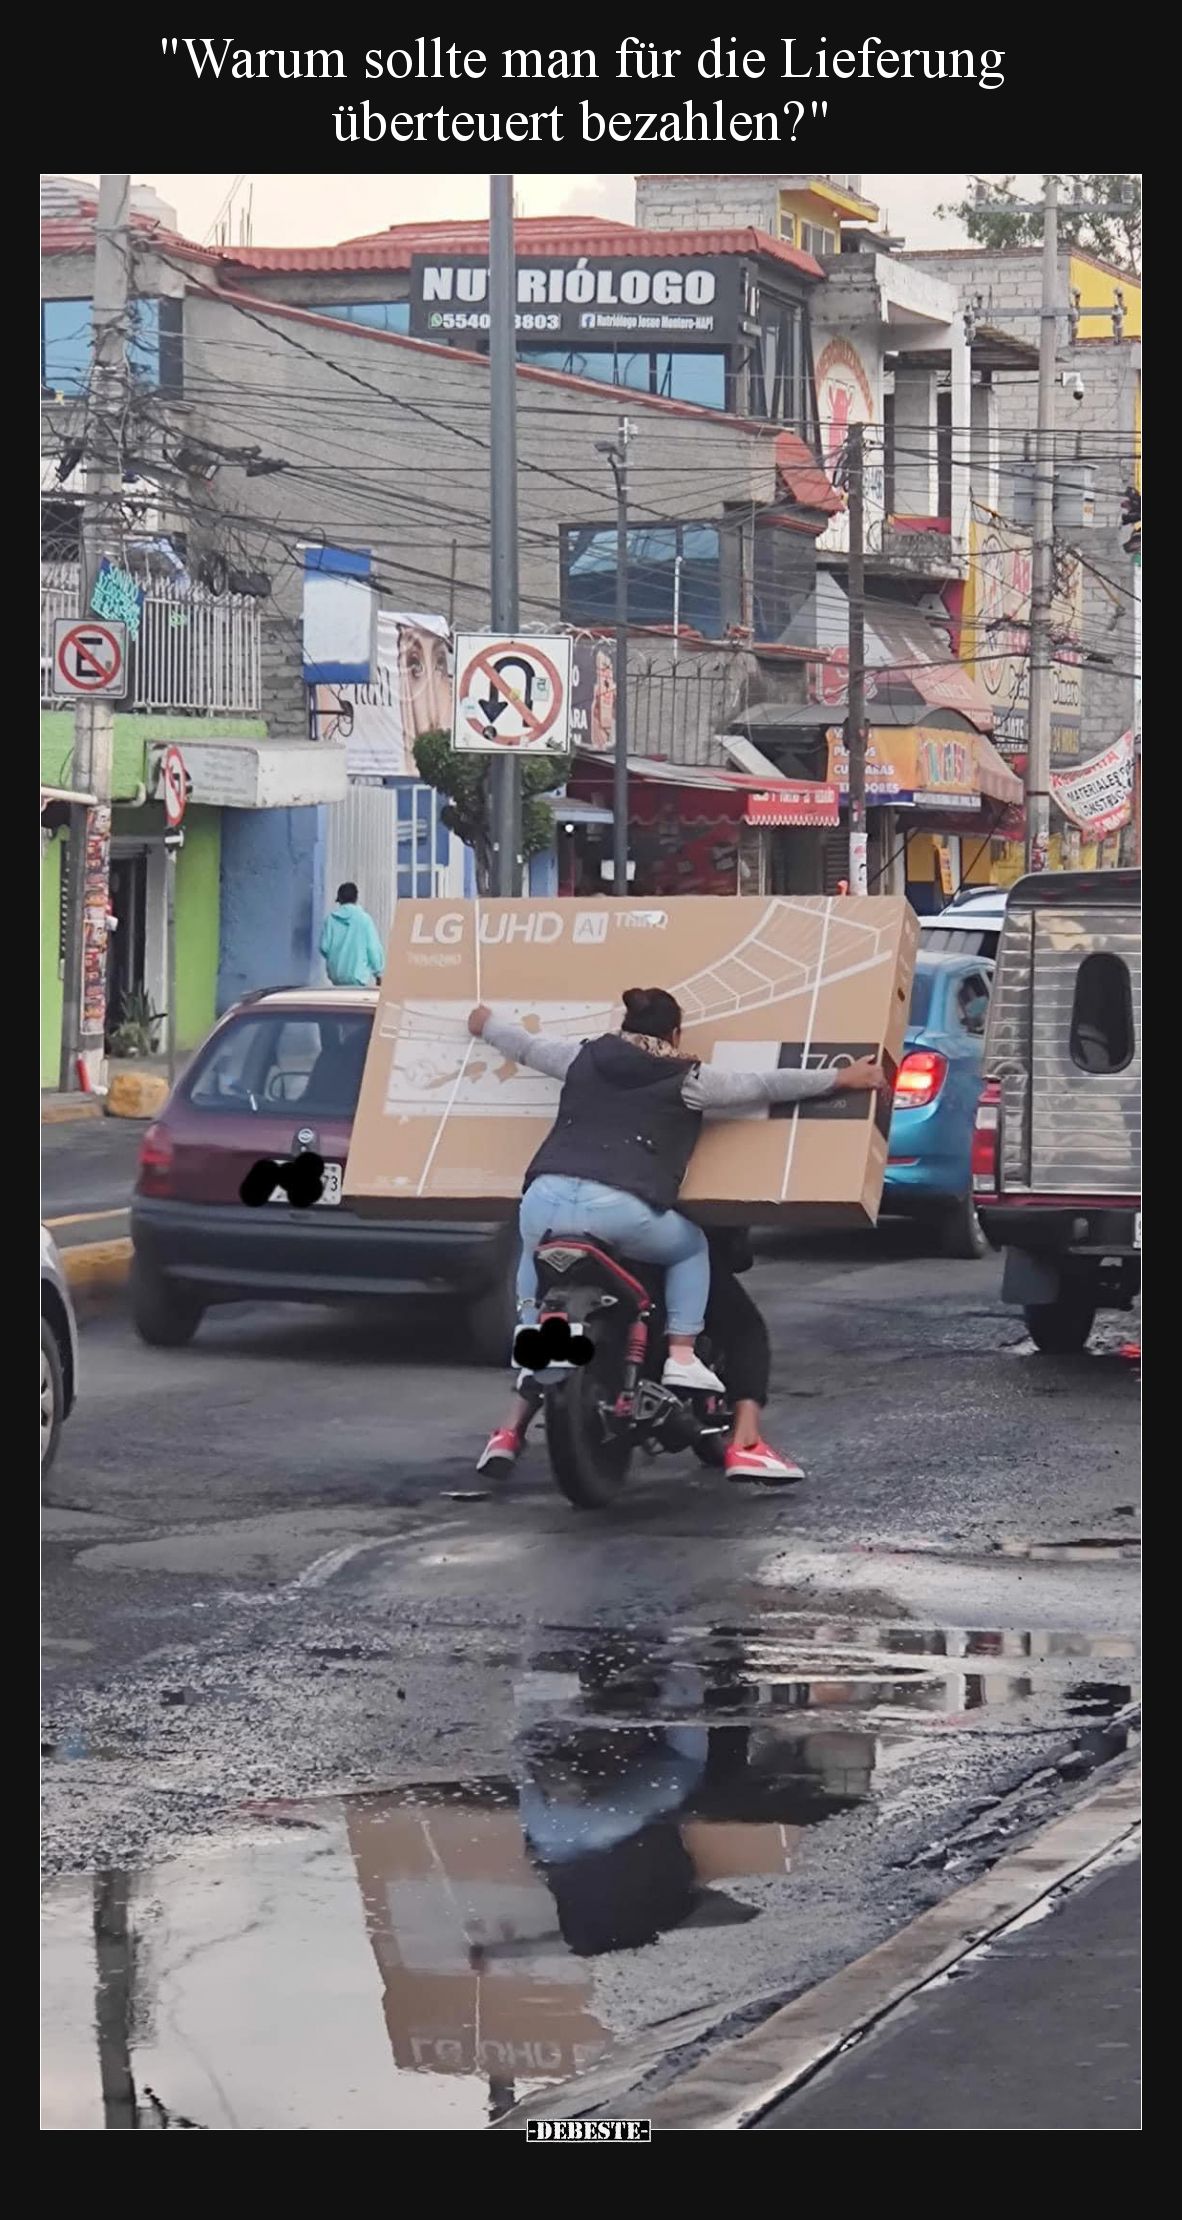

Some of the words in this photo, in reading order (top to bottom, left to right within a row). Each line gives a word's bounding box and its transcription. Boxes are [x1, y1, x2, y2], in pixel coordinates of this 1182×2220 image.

[422, 257, 716, 305] NURIÓLOGO
[410, 911, 465, 945] LG
[478, 911, 564, 944] UHD
